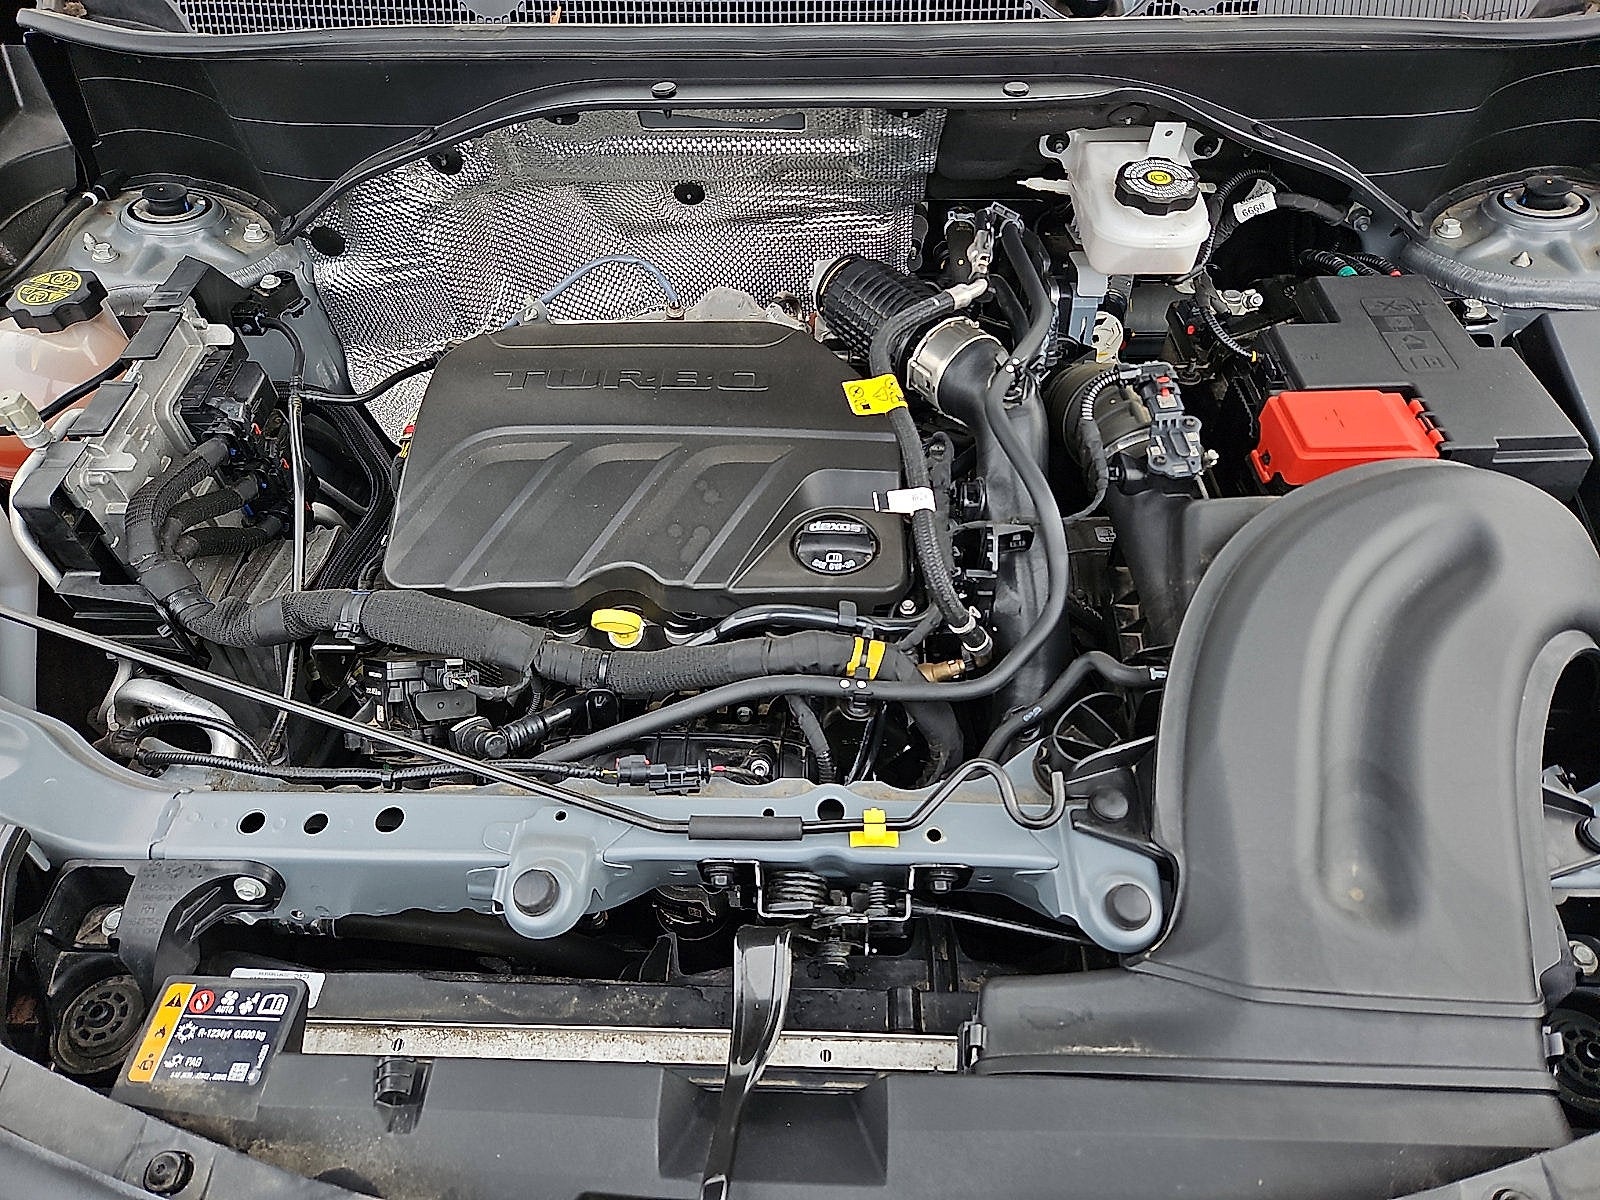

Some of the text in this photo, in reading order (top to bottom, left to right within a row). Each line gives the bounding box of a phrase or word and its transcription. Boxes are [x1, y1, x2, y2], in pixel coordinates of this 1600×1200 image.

[493, 369, 769, 391] TURBO
[809, 521, 861, 533] dexos
[215, 1005, 235, 1014] AUTO
[184, 1056, 203, 1068] PAG
